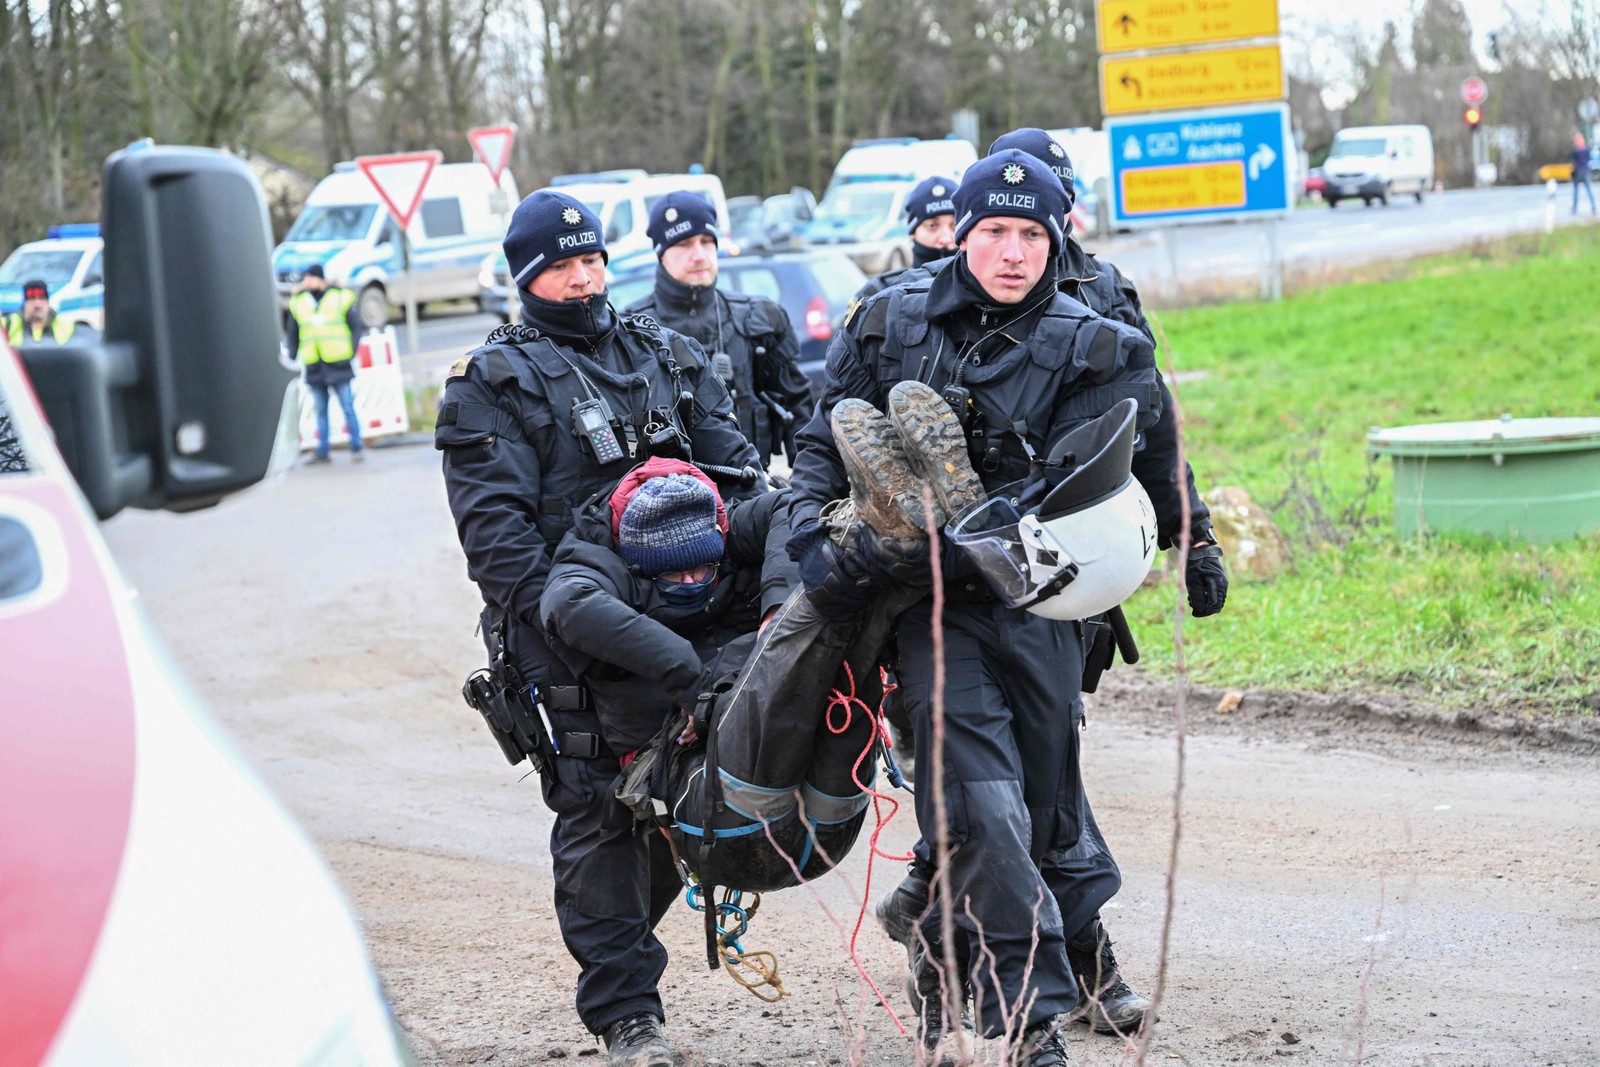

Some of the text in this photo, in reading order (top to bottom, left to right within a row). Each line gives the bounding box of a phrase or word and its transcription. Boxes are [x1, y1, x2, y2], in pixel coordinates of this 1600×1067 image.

[988, 193, 1036, 209] POLIZEI
[664, 220, 693, 239] POLIZEI
[558, 230, 597, 249] POLIZEI
